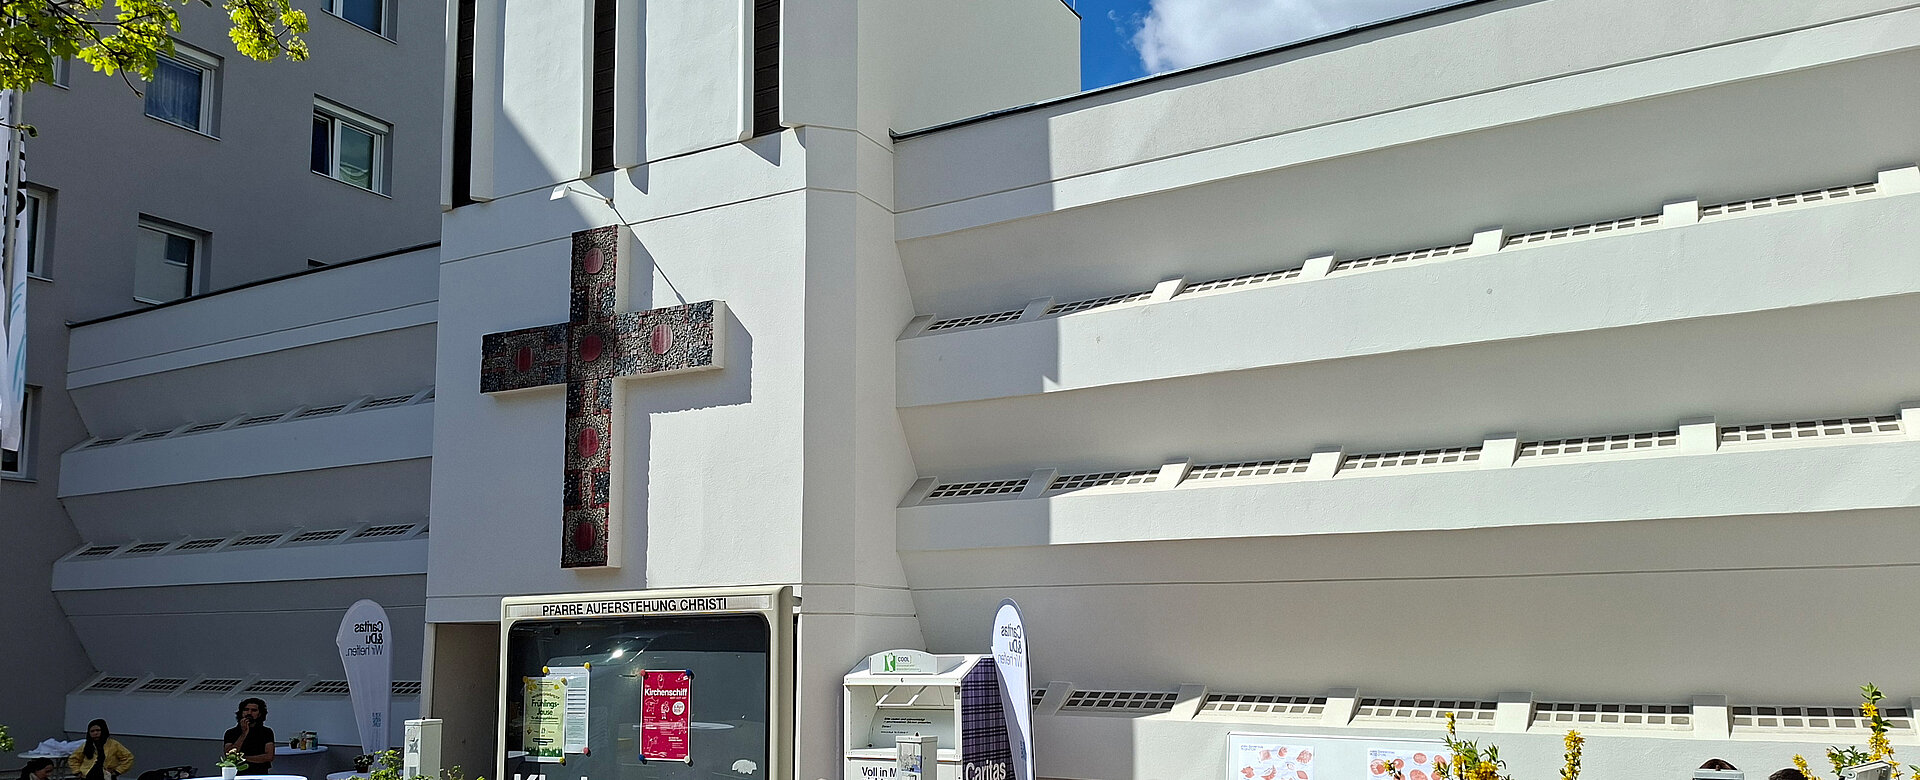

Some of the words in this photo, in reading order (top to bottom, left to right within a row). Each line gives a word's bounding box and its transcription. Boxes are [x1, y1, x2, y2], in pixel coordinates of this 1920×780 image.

[542, 603, 583, 616] PFARRE
[586, 599, 677, 615] AUFERSTEHUNG
[679, 597, 727, 611] CHRISTI
[644, 688, 688, 696] Kirchenschiff
[531, 698, 560, 709] Frühlings-
[536, 707, 554, 716] Jause
[861, 766, 878, 777] Voll
[879, 766, 888, 777] in
[889, 767, 897, 778] M
[965, 759, 1006, 780] Caritas
